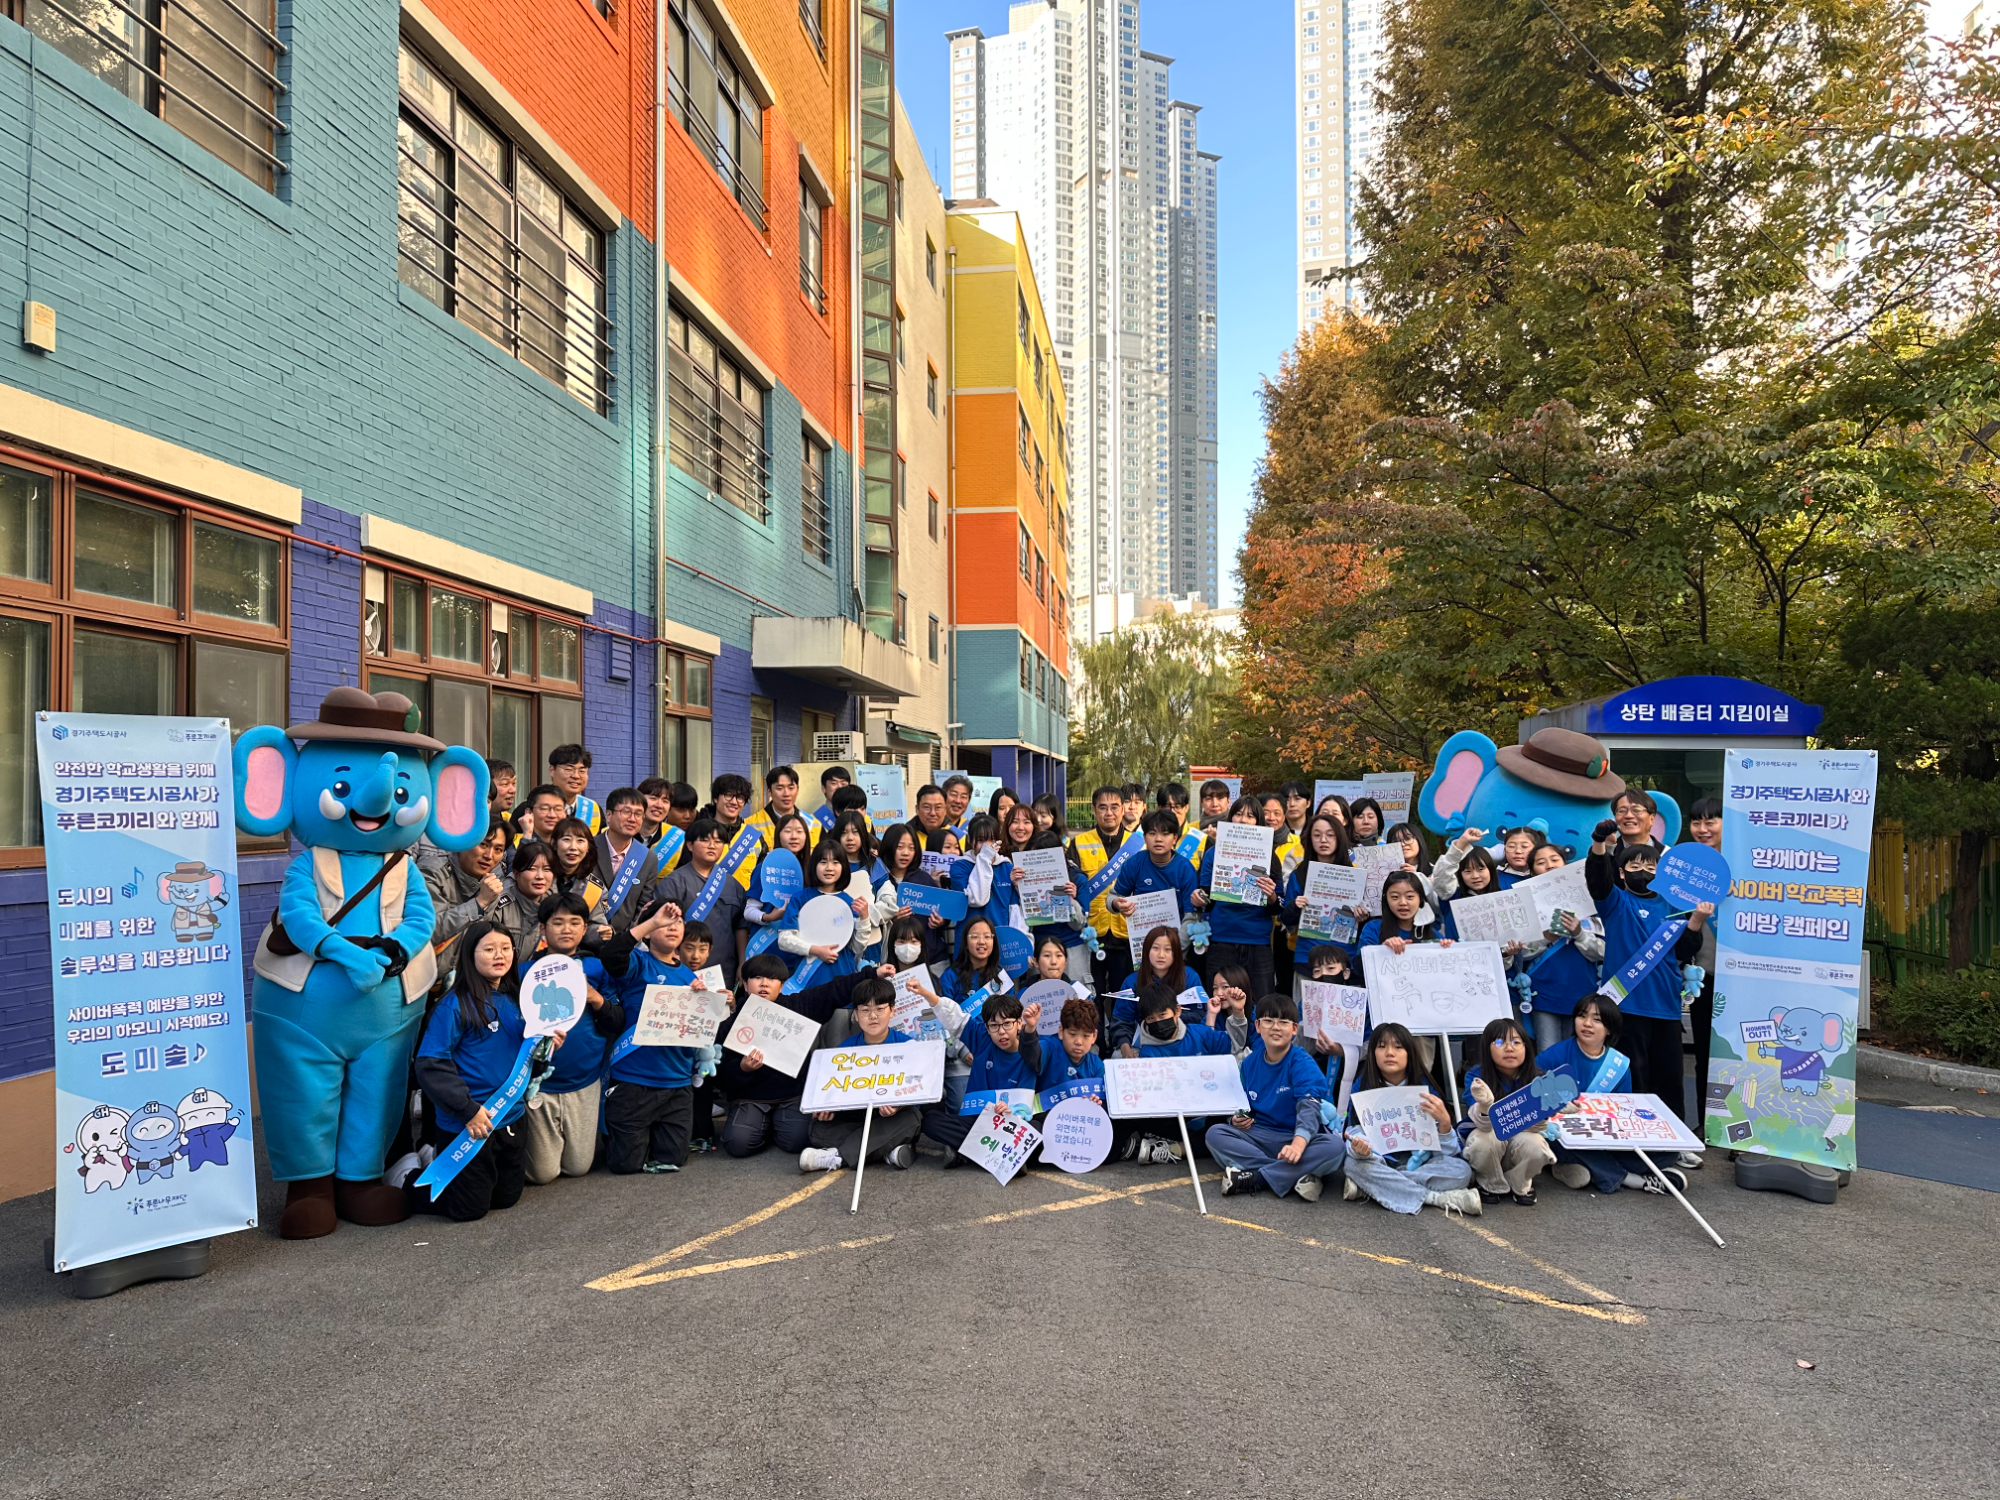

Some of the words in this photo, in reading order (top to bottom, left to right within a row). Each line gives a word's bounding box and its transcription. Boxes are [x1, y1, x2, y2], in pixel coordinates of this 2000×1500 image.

[1620, 704, 1655, 722] 상탄
[1661, 704, 1712, 722] 배움터
[1719, 704, 1789, 722] 지킴이실
[71, 729, 127, 738] 경기주택도시공사
[54, 761, 103, 778] 안전한
[106, 761, 182, 778] 학교생활을
[185, 762, 216, 778] 위해
[55, 785, 219, 803] 경기주택도시공사가
[1730, 785, 1870, 805] 경기주택도시공사와
[57, 811, 178, 831] 푸른코끼리와
[180, 810, 219, 830] 함께
[1748, 810, 1849, 830] 푸른코끼리가
[727, 833, 753, 867] 사이버폭력
[1751, 847, 1840, 873] 함께하는
[611, 858, 638, 904] 사이버폭력
[1693, 866, 1717, 882] 없으면
[57, 886, 113, 907] 도시의
[903, 888, 923, 899] Stop
[1786, 882, 1864, 908] 학교폭력
[901, 897, 940, 911] Violence!
[59, 920, 113, 942] 미래를
[118, 916, 156, 937] 위한
[1735, 911, 1780, 935] 예방
[1782, 915, 1850, 941] 캠페인
[60, 952, 136, 977] 솔루션을
[141, 944, 231, 969] 제공합니다
[67, 1000, 142, 1023] 사이버폭력
[146, 995, 191, 1013] 예방을
[193, 992, 225, 1008] 위한
[67, 1025, 112, 1044] 우리의
[116, 1019, 162, 1038] 하모니
[165, 1012, 229, 1031] 시작해요!
[831, 1053, 880, 1071] 언어
[821, 1072, 905, 1092] 사이버
[1495, 1094, 1527, 1117] 함께해요!
[1056, 1113, 1101, 1127] 사이버폭력을
[1498, 1109, 1521, 1126] 안전한
[1502, 1110, 1538, 1134] 사이버세상
[1055, 1124, 1086, 1135] 외면하지
[1560, 1117, 1619, 1140] 폭력
[1054, 1134, 1094, 1147] 않겠습니다.
